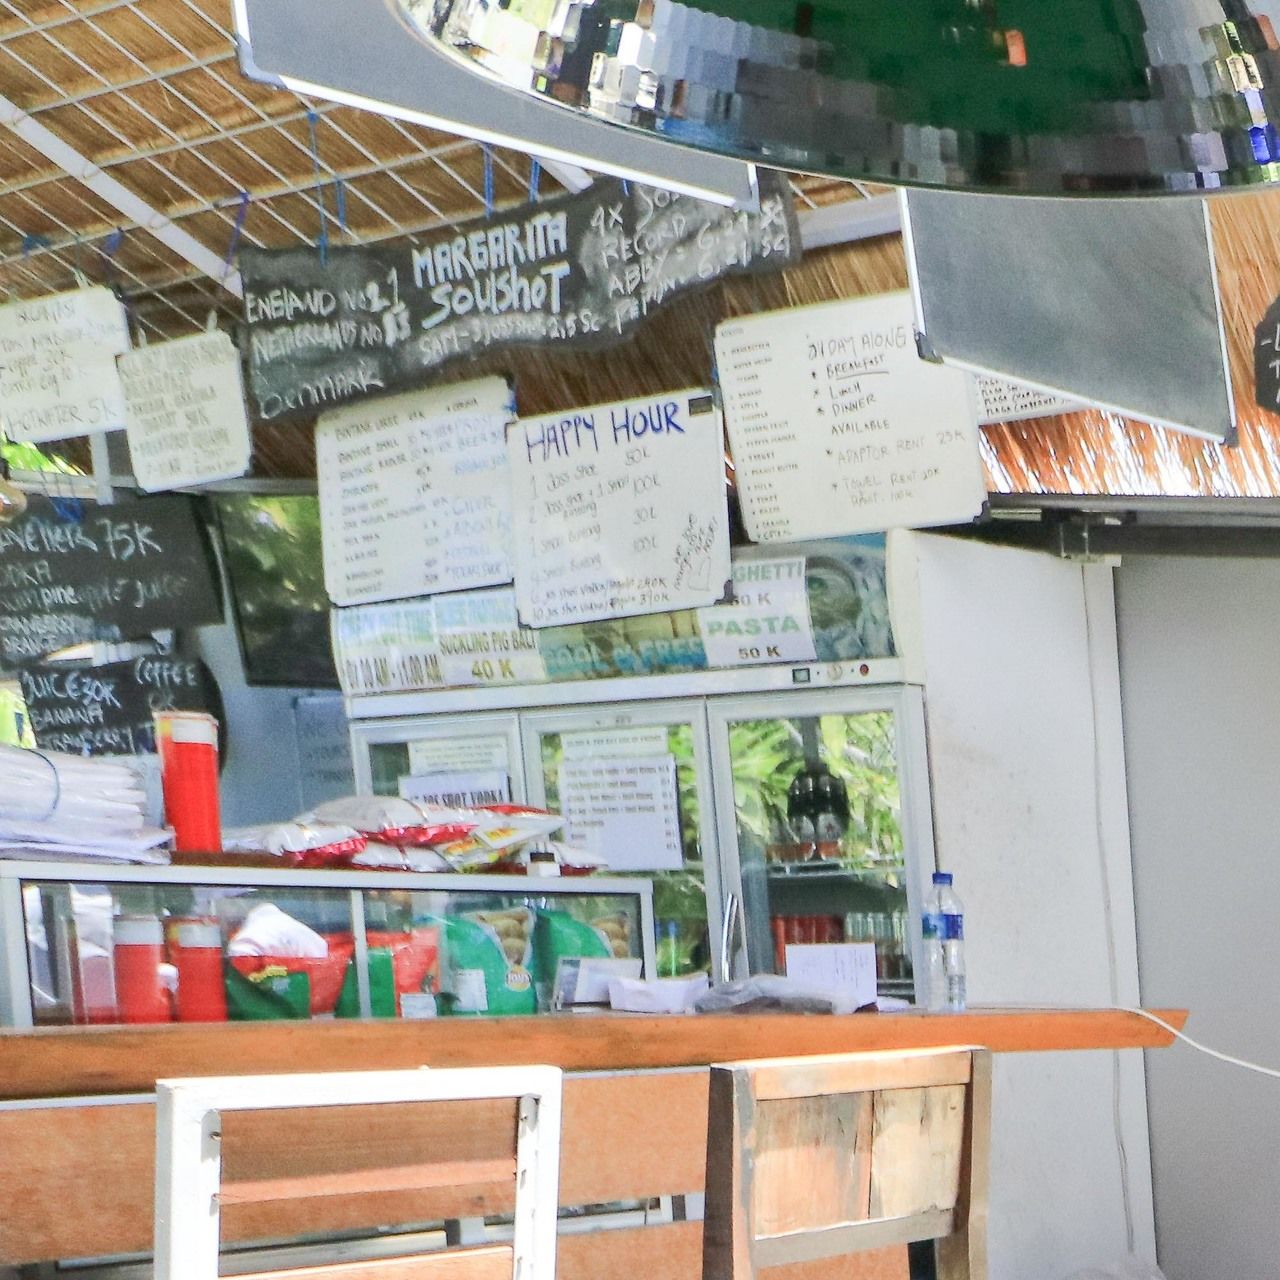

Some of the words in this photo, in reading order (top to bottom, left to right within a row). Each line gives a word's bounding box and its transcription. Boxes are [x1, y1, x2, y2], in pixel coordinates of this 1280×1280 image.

[412, 211, 568, 289] MARGARITA
[832, 393, 877, 417] DINNER
[524, 413, 599, 464] HAPPY
[611, 401, 685, 445] HOUR
[831, 419, 891, 436] AVAILABLE
[96, 517, 163, 561] 75K
[733, 562, 803, 582] GHETTI
[707, 616, 801, 636] PASTA
[738, 647, 761, 660] 50
[767, 644, 782, 658] K
[472, 660, 495, 679] 40
[499, 658, 515, 678] K
